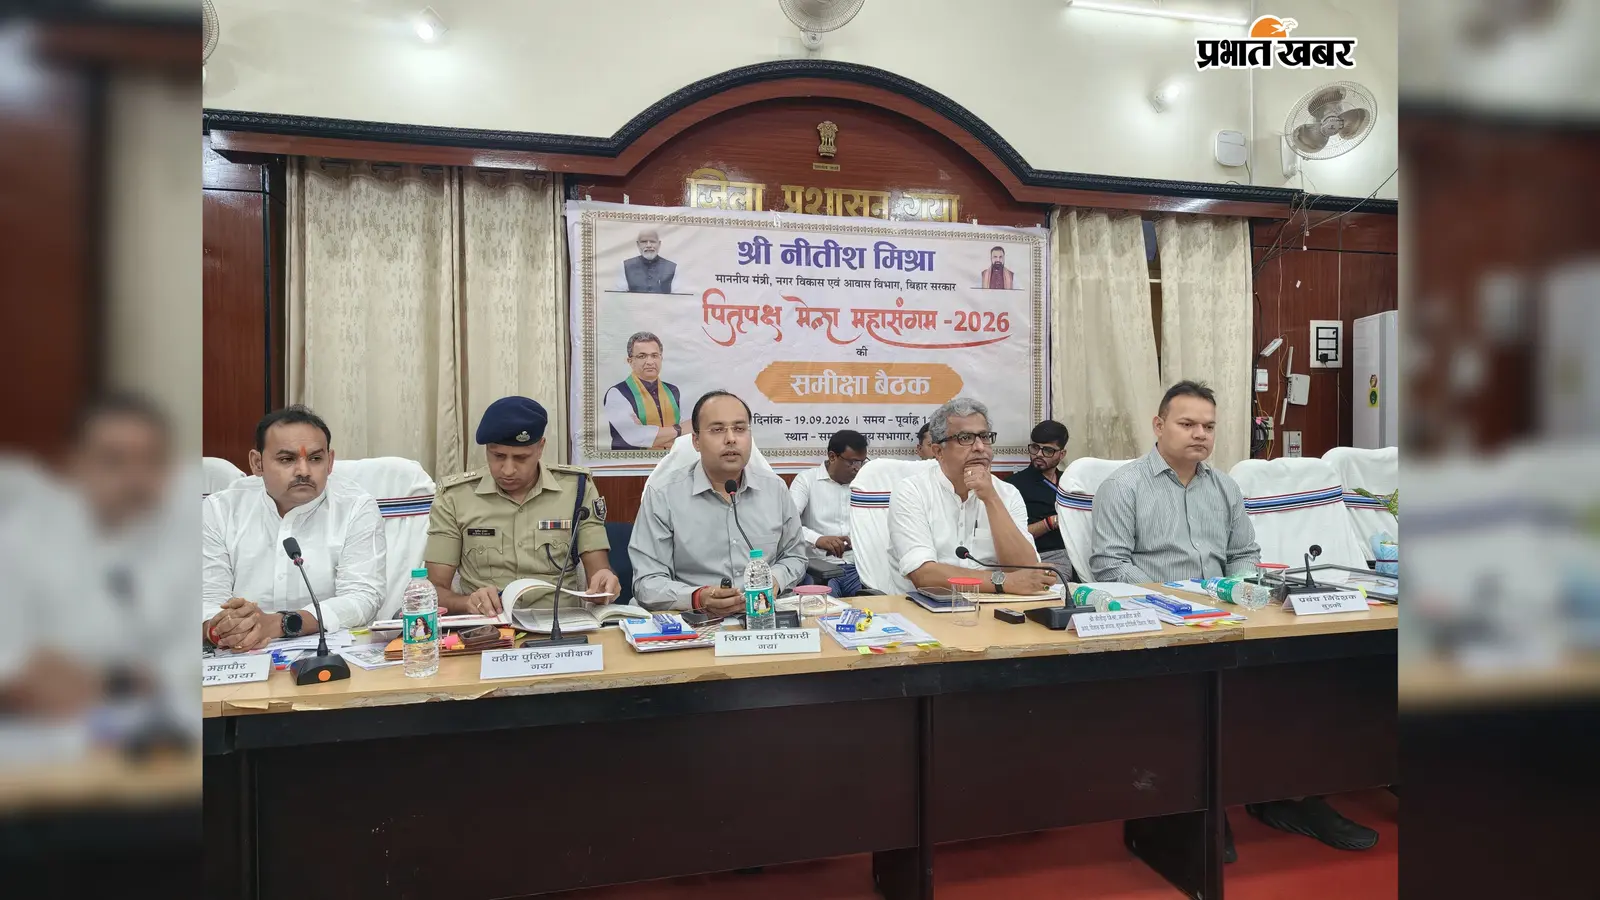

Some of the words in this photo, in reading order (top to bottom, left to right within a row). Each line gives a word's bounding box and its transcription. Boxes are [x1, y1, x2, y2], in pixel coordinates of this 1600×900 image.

[781, 184, 891, 220] प्रशासन
[738, 235, 773, 265] श्री
[780, 238, 867, 270] नीतीश
[873, 241, 936, 272] मिश्रा
[715, 274, 749, 284] माननीय
[752, 274, 772, 286] मंत्री,
[775, 277, 793, 286] नगर
[797, 275, 824, 286] विकास
[828, 277, 841, 288] एवं
[843, 279, 871, 288] आवास
[873, 278, 902, 291] विभाग,
[906, 279, 928, 291] बिहार
[930, 282, 956, 292] सरकार
[702, 288, 783, 346] पितृपक्ष
[781, 293, 863, 345] मेला
[851, 297, 940, 345] महासंगम
[856, 346, 868, 357] की
[790, 369, 869, 396] समीक्षा
[874, 369, 931, 396] बैठक
[753, 413, 783, 425] दिनांक
[794, 416, 850, 425] 19.09.2026
[863, 415, 886, 424] समय
[895, 412, 920, 427] पूर्वाह्न
[784, 432, 809, 441] स्थान
[876, 432, 914, 442] सभागार,
[756, 631, 810, 640] पदाधिकारी
[492, 653, 519, 662] वरीय
[522, 651, 551, 663] पुलिस
[555, 649, 593, 659] अधीक्षक
[207, 661, 247, 672] महापौर
[531, 662, 554, 670] गया
[227, 672, 256, 680] गया
